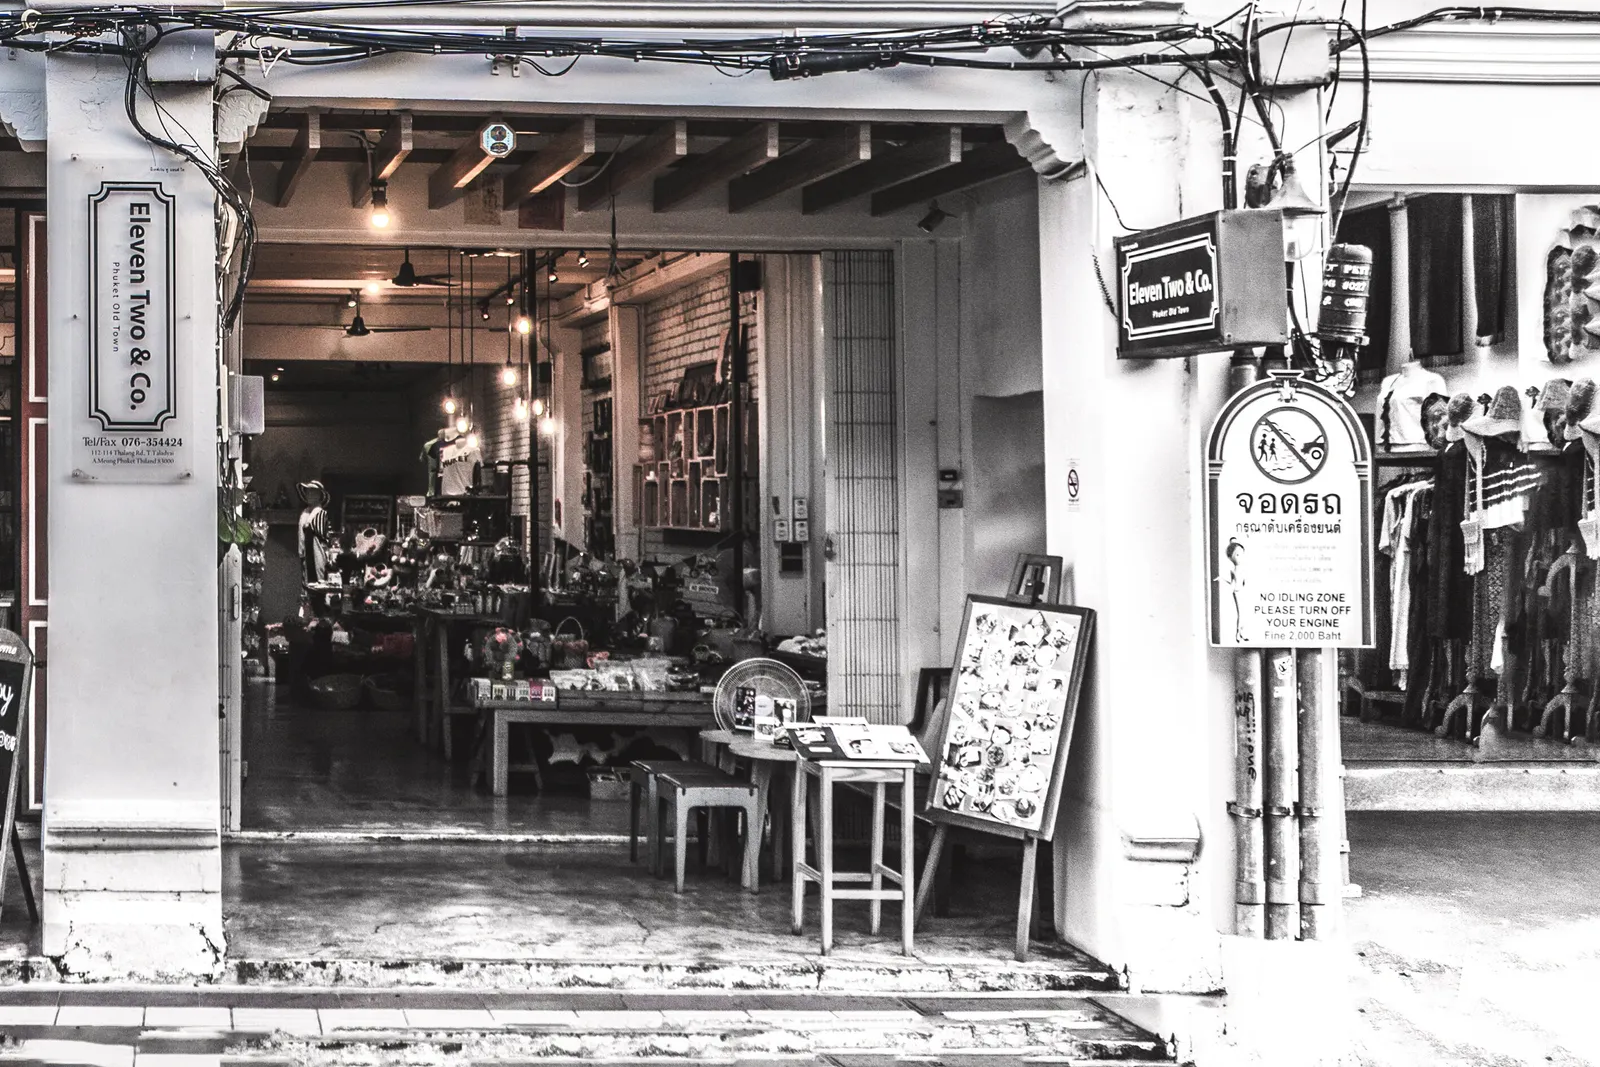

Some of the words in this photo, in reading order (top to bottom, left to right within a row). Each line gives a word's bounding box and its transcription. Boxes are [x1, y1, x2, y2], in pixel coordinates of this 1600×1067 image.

[129, 202, 151, 284] Eleven
[112, 262, 121, 298] Phuket
[1129, 281, 1163, 306] Eleven
[1161, 275, 1184, 299] Two
[1185, 271, 1195, 295] &
[1195, 268, 1212, 293] Co.
[112, 303, 121, 321] Old
[129, 289, 151, 341] Two
[112, 326, 121, 352] Town
[130, 347, 151, 366] &
[130, 372, 151, 410] Co.
[82, 436, 117, 447] Tel/Fax
[121, 437, 184, 447] 076-354424
[1236, 492, 1341, 514] จอดรถ
[1236, 515, 1341, 538] กรุณาดับเครื่องยนต์
[1260, 593, 1275, 602] NO
[1278, 593, 1314, 602] IDLING
[1317, 593, 1345, 602] ZONE
[1254, 605, 1295, 614] PLEASE
[1300, 605, 1328, 614] TURN
[1331, 605, 1351, 615] OFF
[1267, 618, 1296, 627] YOUR
[1299, 618, 1339, 627] ENGINE
[1264, 630, 1285, 640] Fine
[1289, 631, 1315, 640] 2,000
[1318, 631, 1342, 640] Baht
